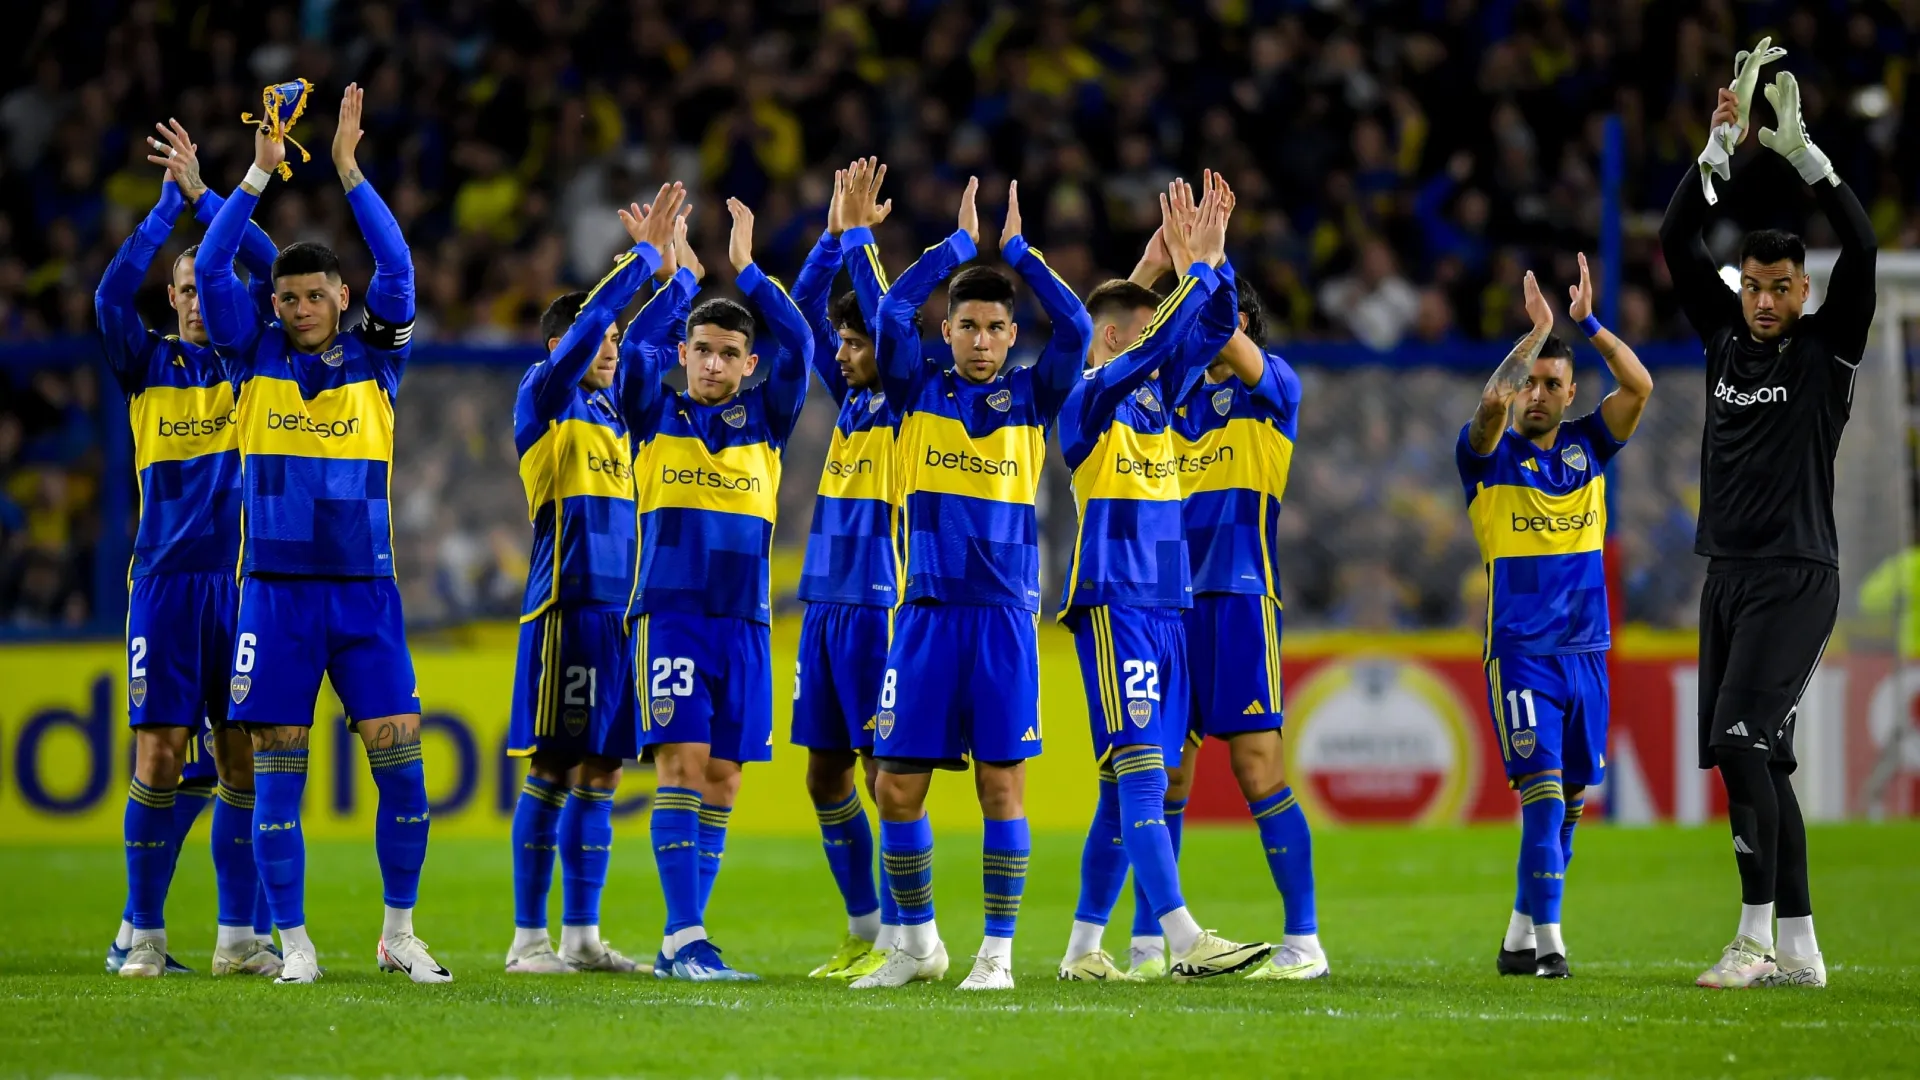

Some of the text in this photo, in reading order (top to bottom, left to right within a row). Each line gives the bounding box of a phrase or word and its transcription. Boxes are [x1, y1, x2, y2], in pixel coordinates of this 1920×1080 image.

[1713, 376, 1788, 406] btsson
[158, 408, 237, 437] betsso
[267, 408, 359, 438] betsson
[662, 465, 760, 493] betsson
[826, 459, 872, 478] sson
[1511, 510, 1599, 532] betsson
[131, 636, 147, 678] 2
[235, 632, 257, 673] 6
[564, 665, 597, 708] 21
[652, 656, 695, 697] 23
[880, 668, 897, 709] 8
[1123, 659, 1161, 702] 22
[1506, 689, 1537, 730] 11
